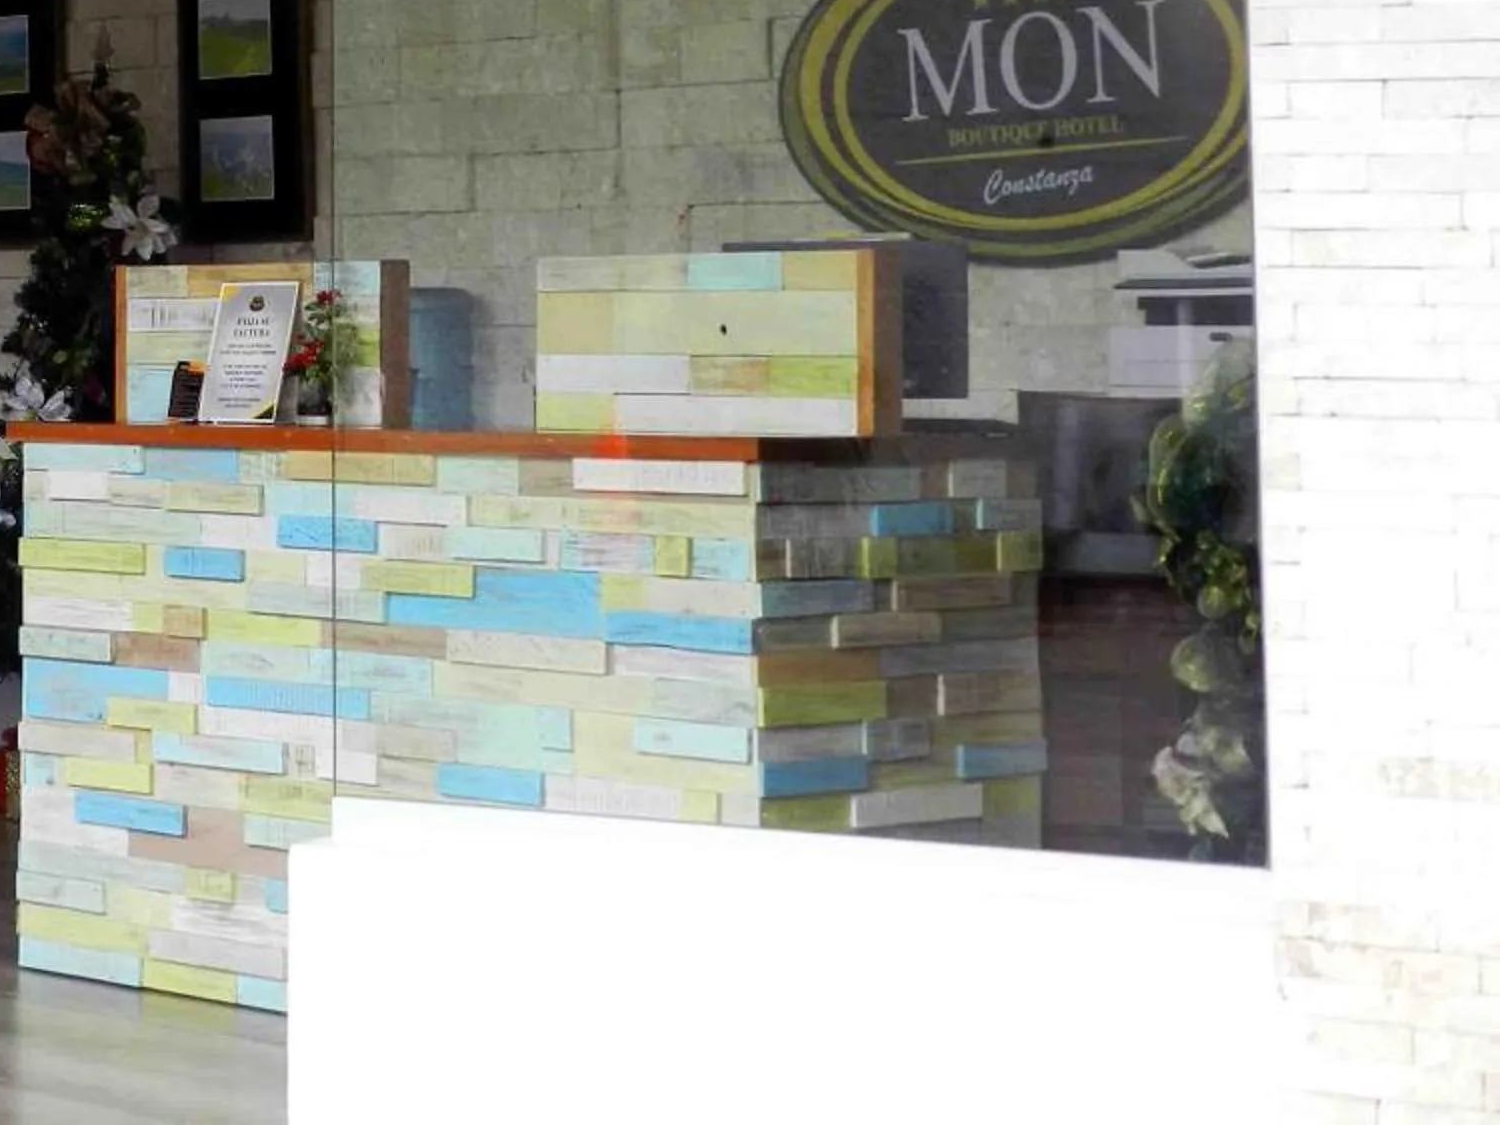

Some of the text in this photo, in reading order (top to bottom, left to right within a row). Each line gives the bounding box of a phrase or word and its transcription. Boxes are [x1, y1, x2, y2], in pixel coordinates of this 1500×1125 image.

[947, 114, 1125, 147] BOUTIQUE HOTEL
[983, 165, 1093, 205] Constanza
